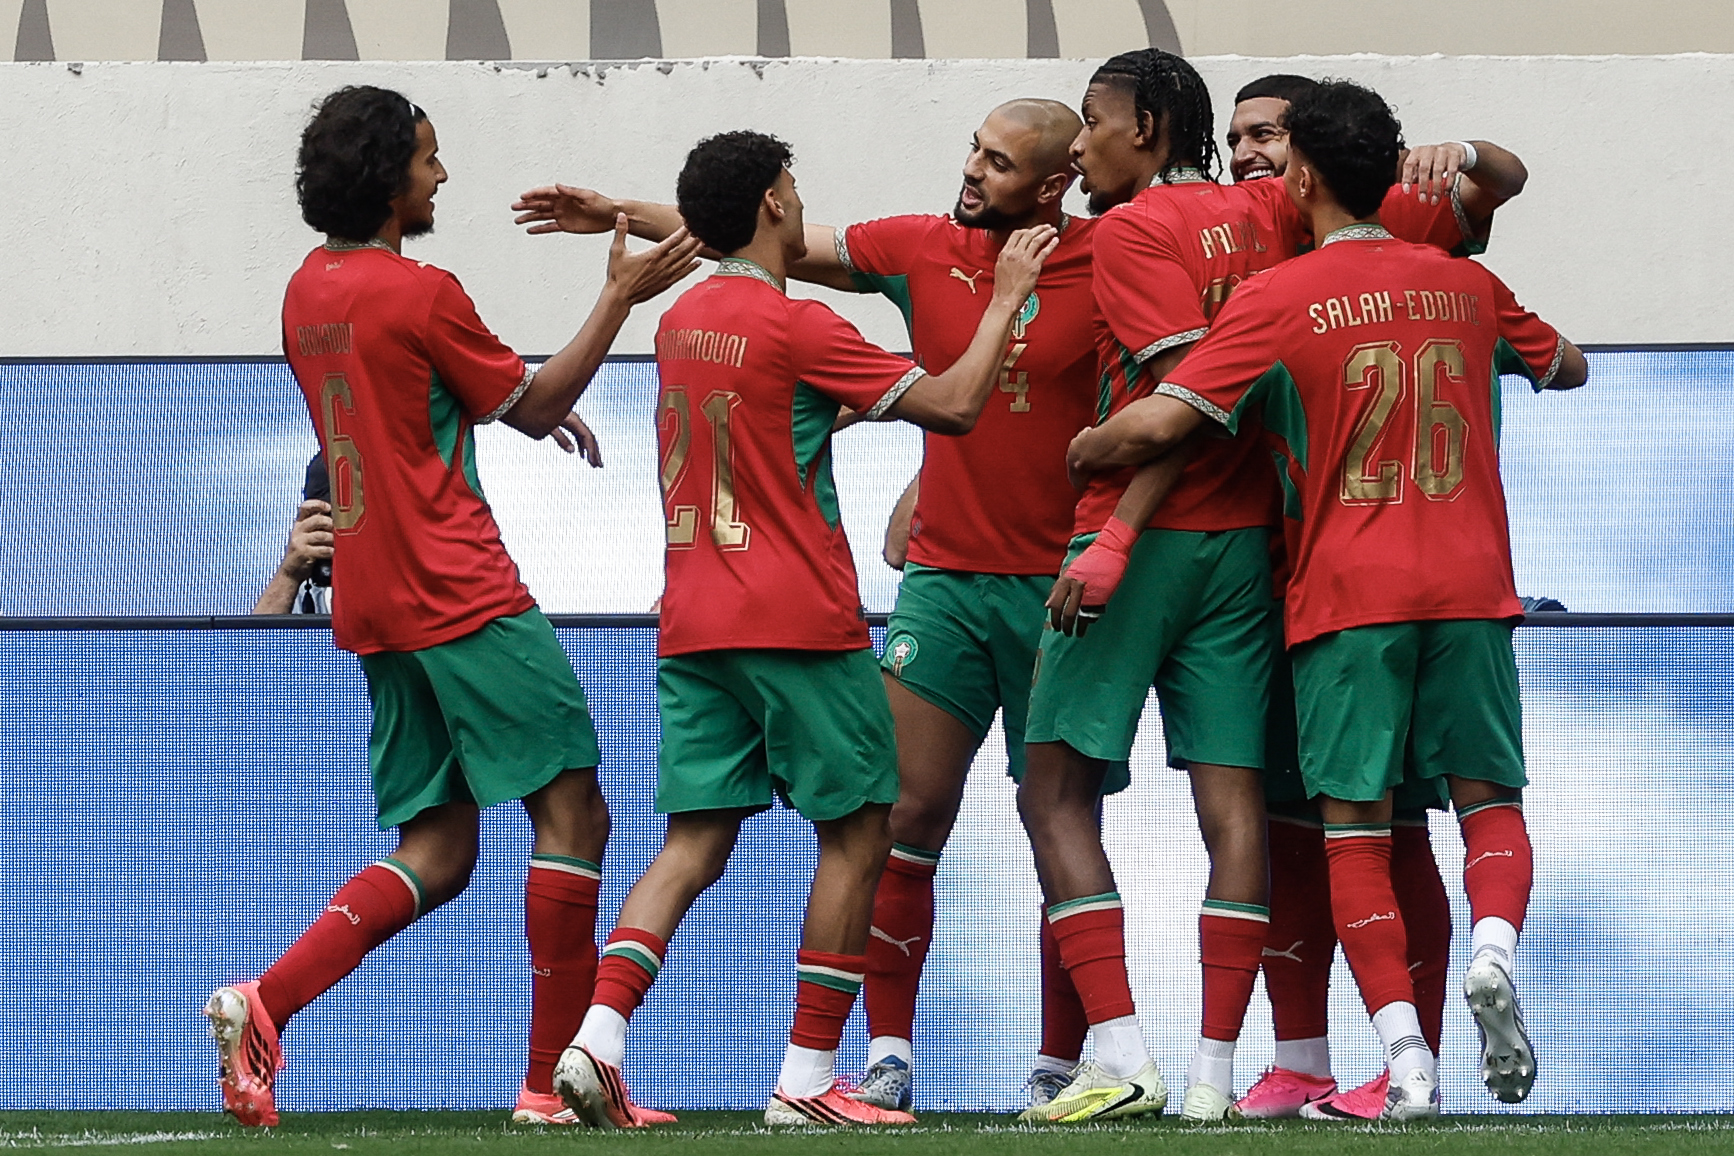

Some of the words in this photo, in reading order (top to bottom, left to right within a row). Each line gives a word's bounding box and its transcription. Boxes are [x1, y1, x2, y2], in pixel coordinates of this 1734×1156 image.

[999, 343, 1030, 412] 4
[1308, 289, 1480, 334] SALAH-EDDINE
[320, 372, 367, 537] 6
[657, 385, 750, 552] 21
[1339, 338, 1469, 506] 26
